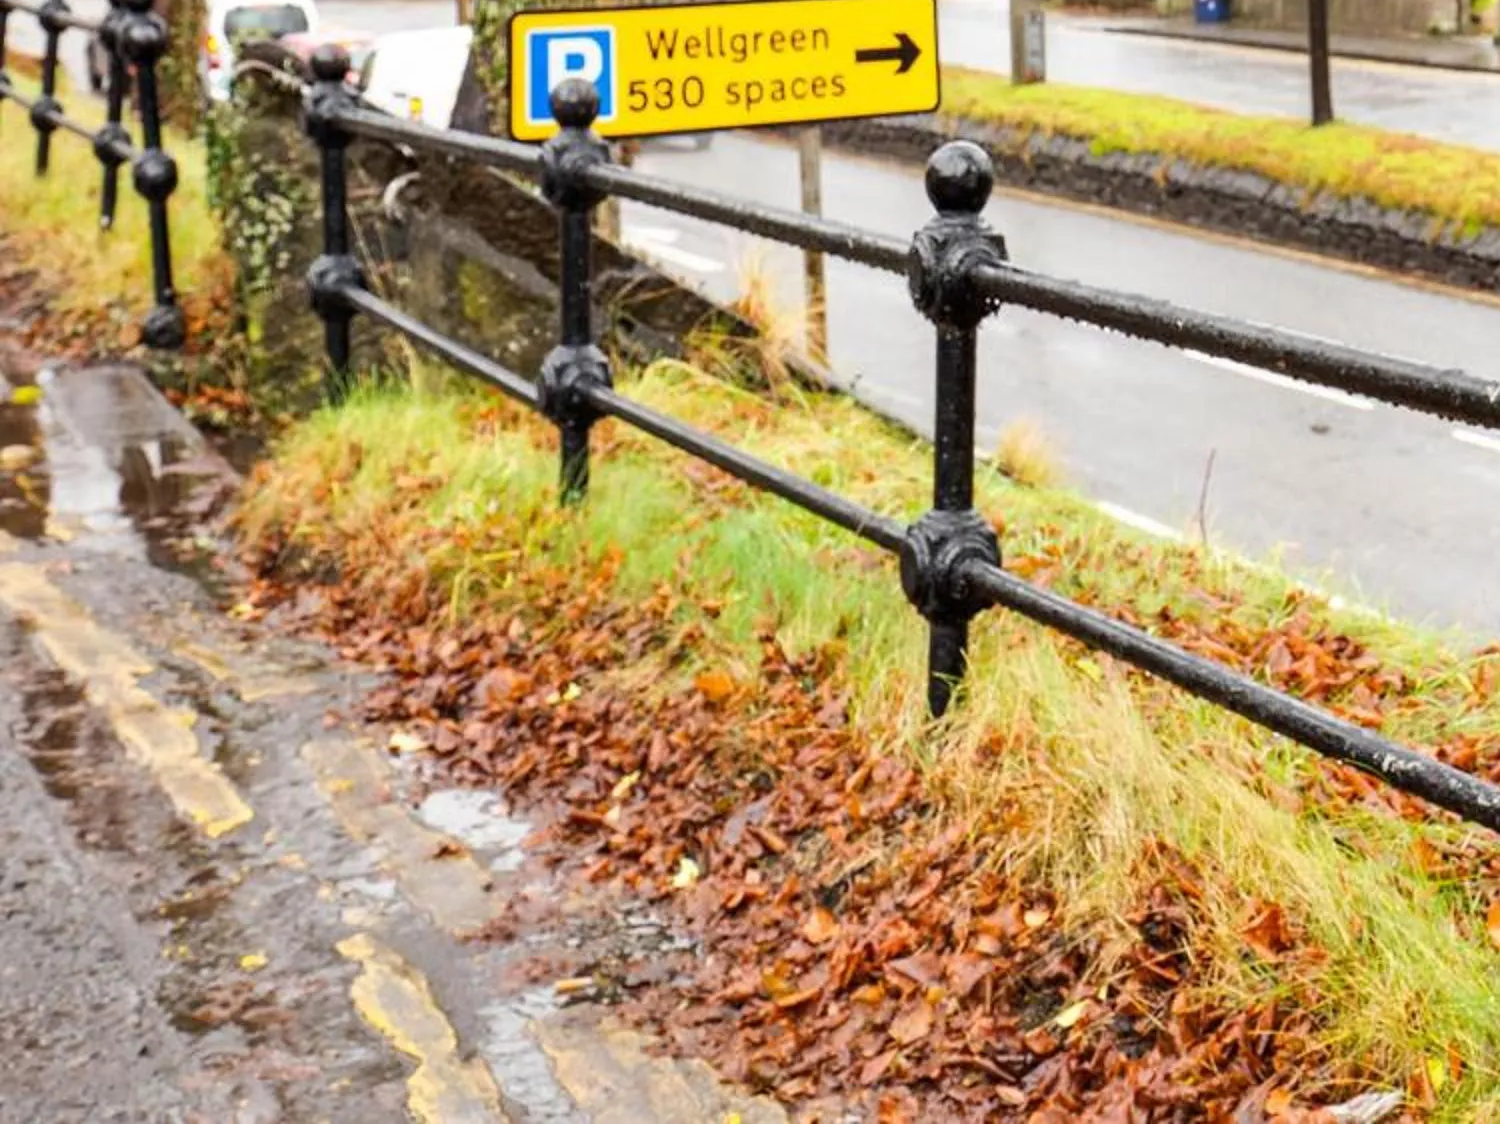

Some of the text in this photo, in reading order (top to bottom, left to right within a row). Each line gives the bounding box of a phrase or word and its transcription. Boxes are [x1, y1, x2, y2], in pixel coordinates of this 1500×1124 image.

[547, 26, 830, 98] P Wellgreen
[628, 74, 846, 114] 530 spaces
